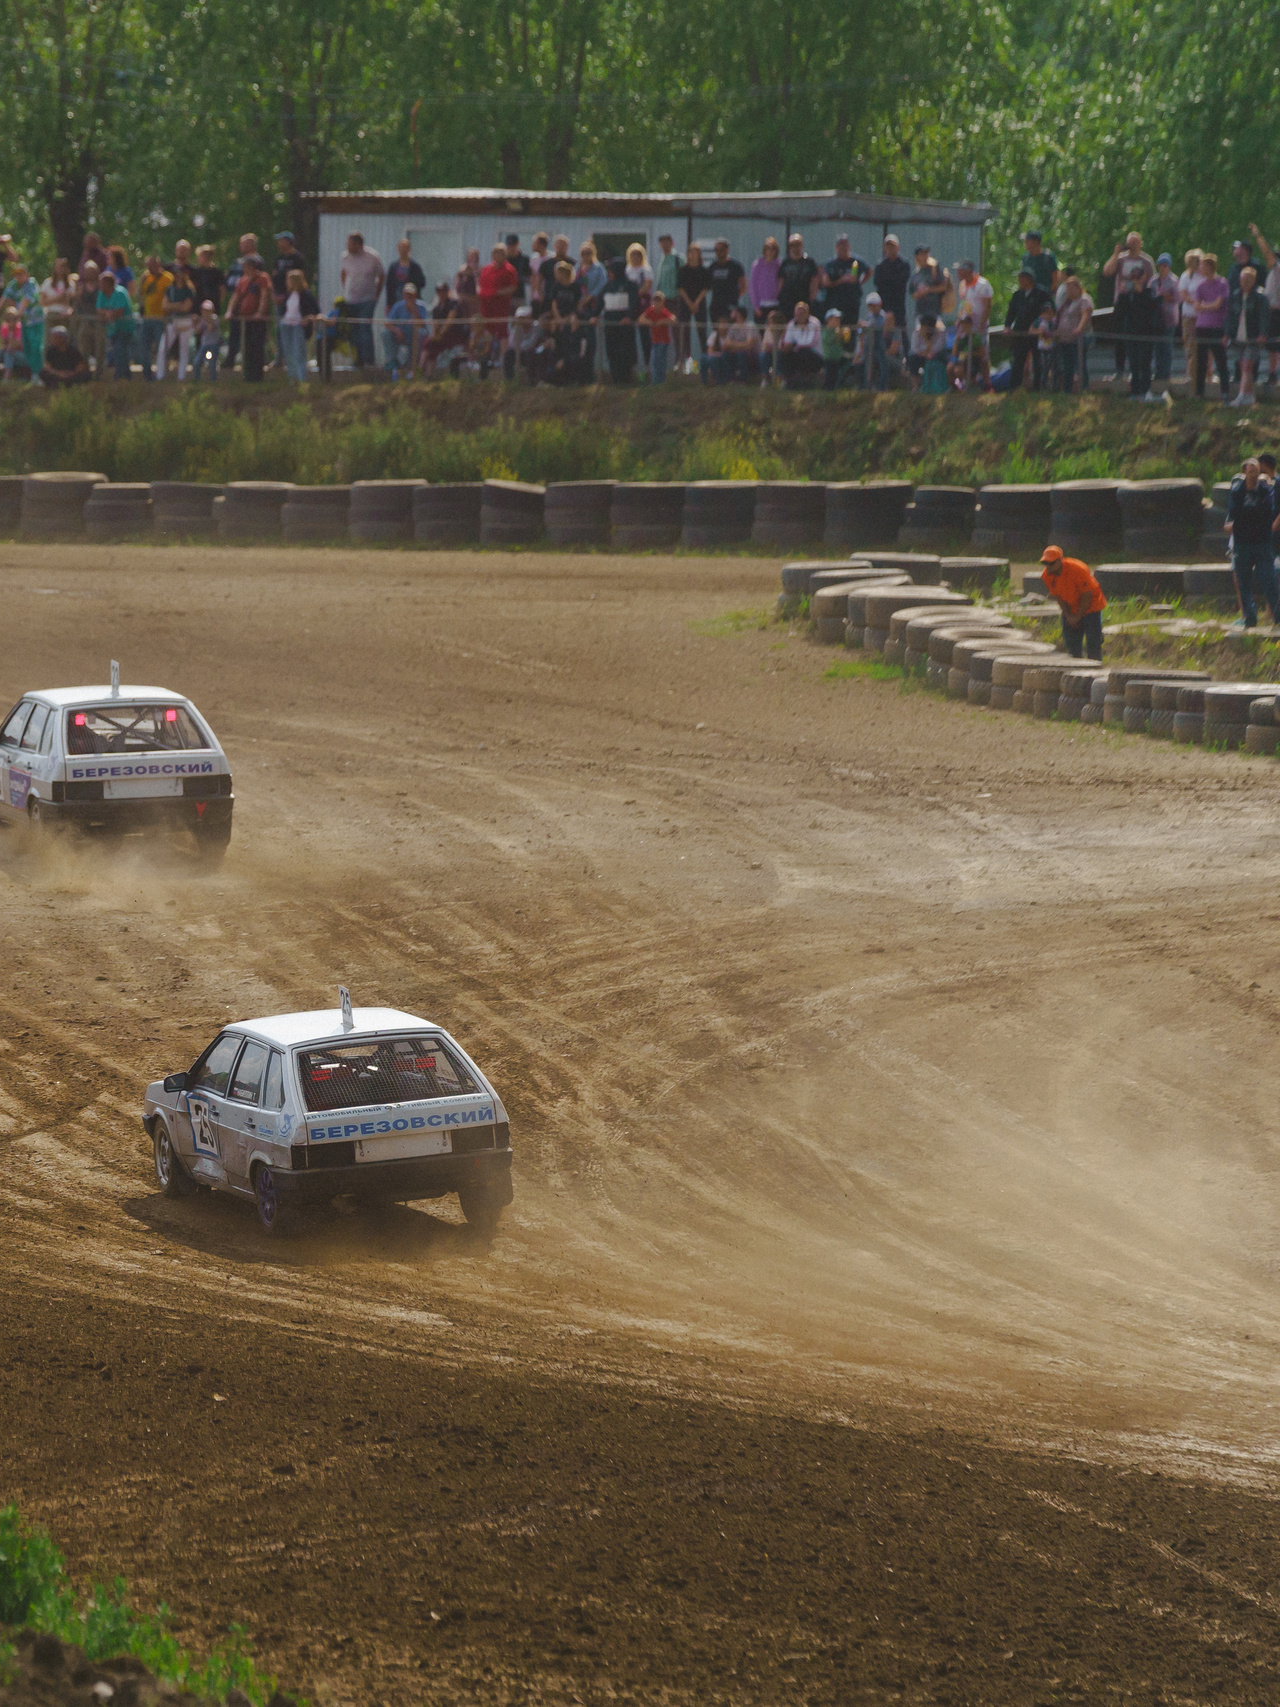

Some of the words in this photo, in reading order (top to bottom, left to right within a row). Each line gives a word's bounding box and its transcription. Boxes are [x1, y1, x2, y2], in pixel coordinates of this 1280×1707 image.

[72, 761, 213, 778] БЕРЕЗОВСКИЙ
[340, 989, 351, 1016] 25
[194, 1103, 215, 1148] 25
[306, 1106, 382, 1120] АВТОМОБИЛЬНЫЙ
[310, 1106, 494, 1140] БЕРЕЗОВСКИЙ
